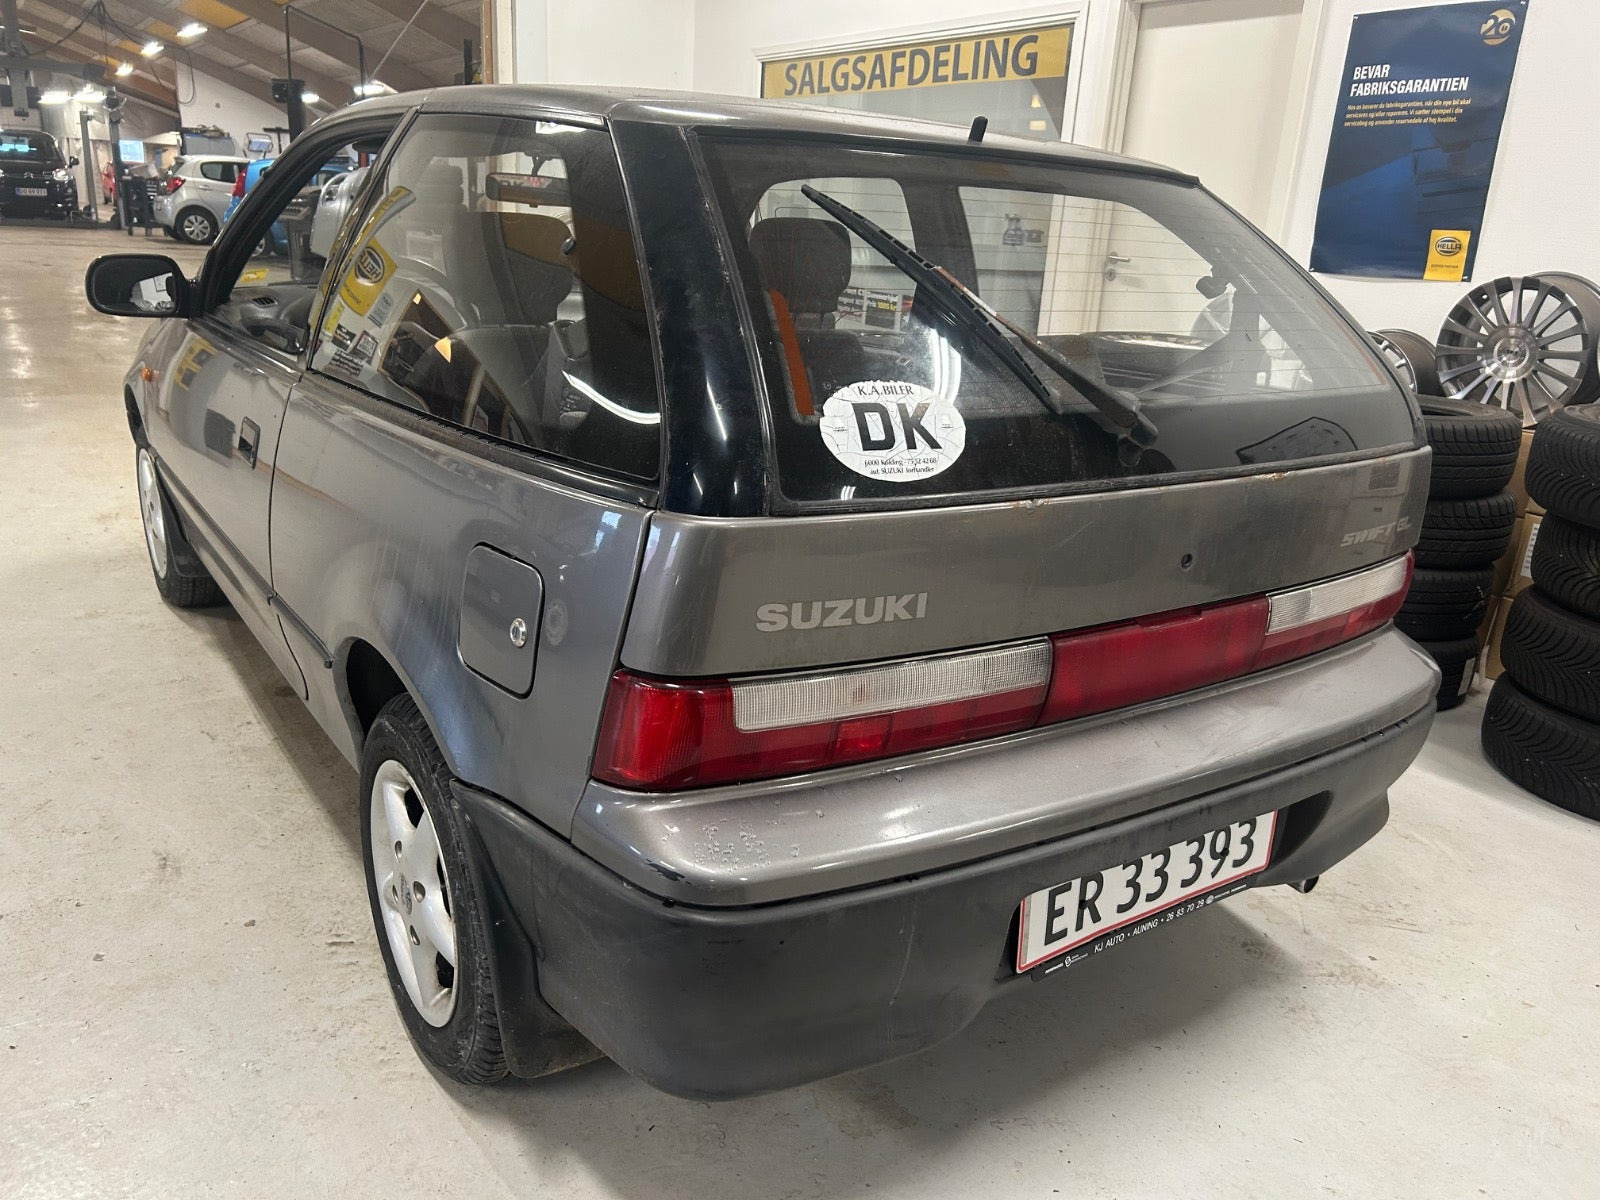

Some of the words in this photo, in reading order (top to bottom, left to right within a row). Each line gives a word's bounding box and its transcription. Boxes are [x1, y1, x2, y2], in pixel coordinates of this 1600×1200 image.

[784, 34, 1039, 97] SALGSAFDELING
[1354, 64, 1390, 80] BEVAR
[1350, 77, 1469, 97] FABRIKSGARANTIEN
[1437, 243, 1462, 251] HELLA
[851, 402, 943, 452] DK
[880, 467, 904, 475] SUZUKI
[755, 592, 928, 632] SUZUKI
[1044, 871, 1104, 945] ER
[1116, 848, 1171, 914] 33
[1180, 817, 1258, 888] 393
[1094, 942, 1104, 953] KJ
[1105, 932, 1125, 948] AUTO
[1132, 918, 1159, 936] AUNING
[1186, 903, 1195, 913] 70
